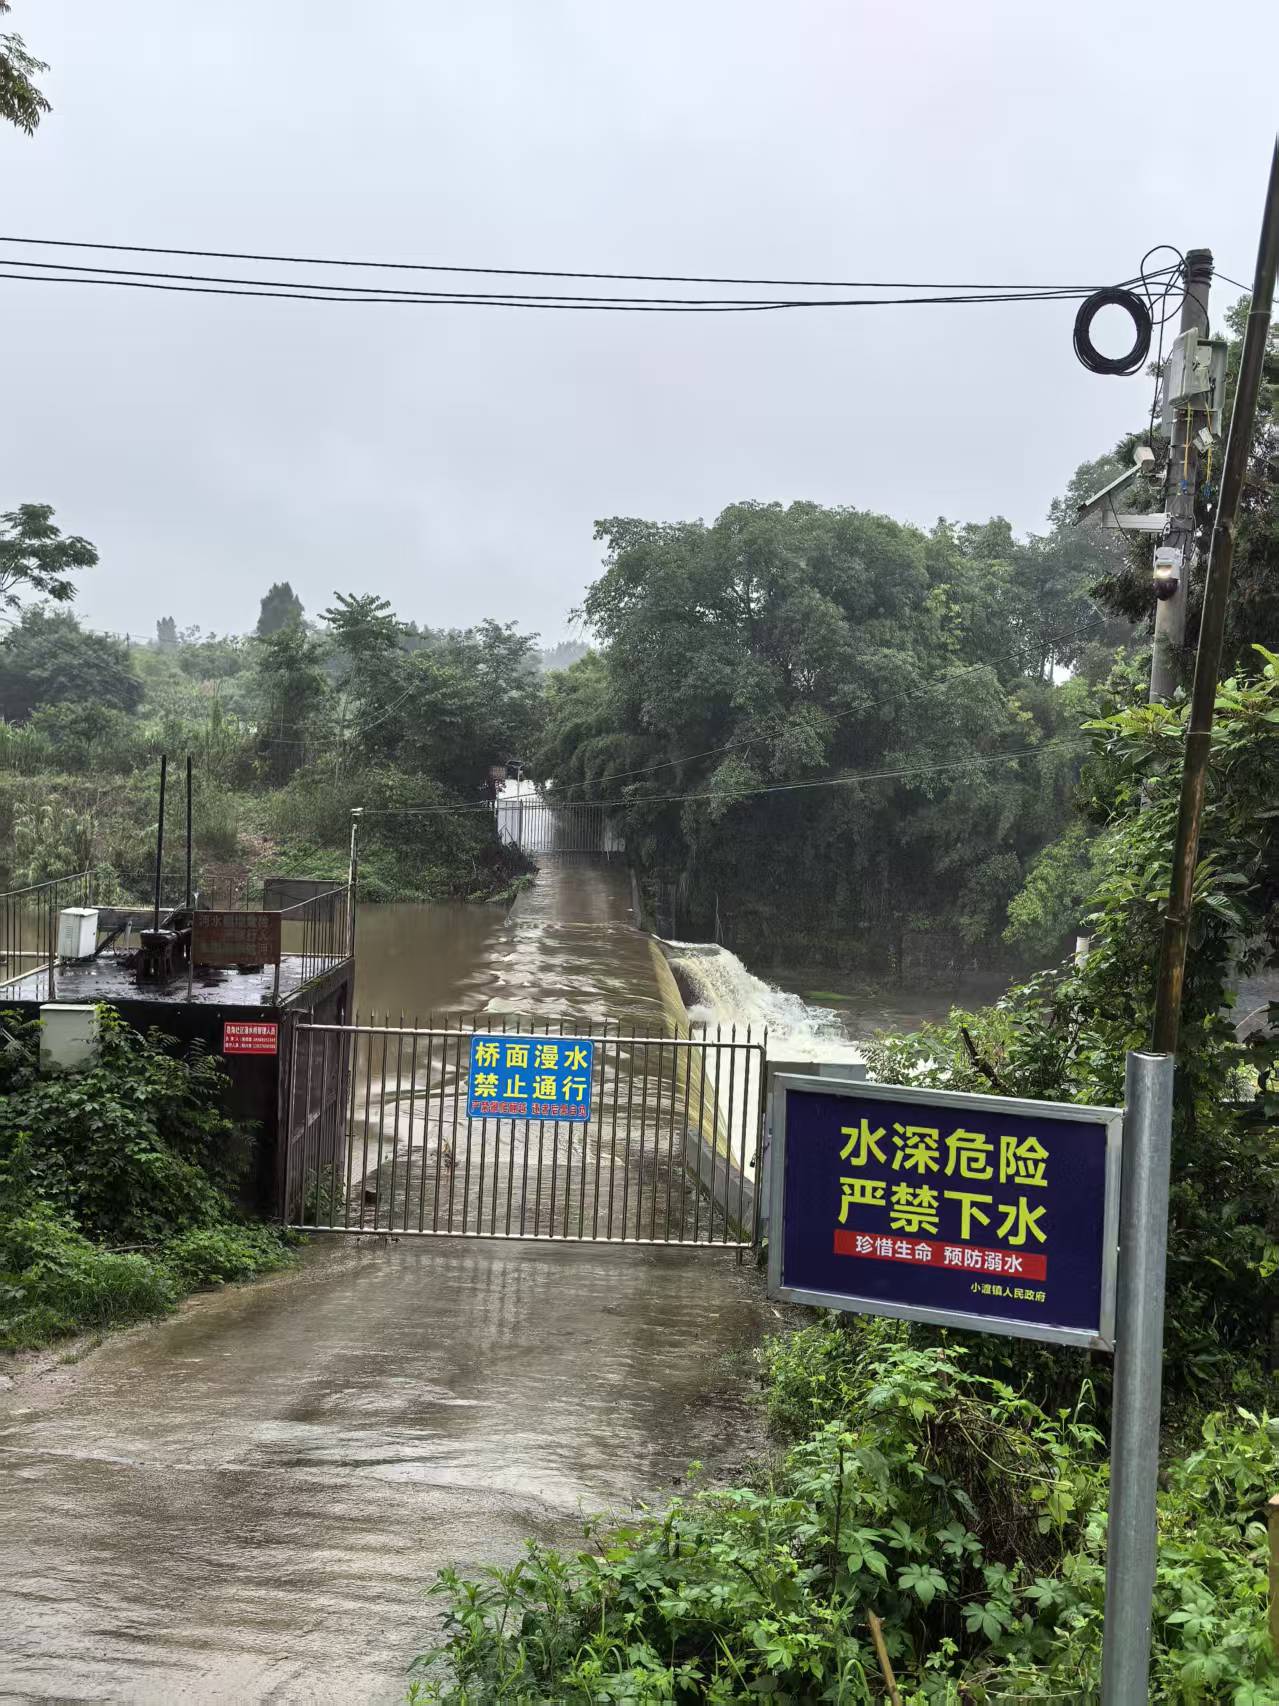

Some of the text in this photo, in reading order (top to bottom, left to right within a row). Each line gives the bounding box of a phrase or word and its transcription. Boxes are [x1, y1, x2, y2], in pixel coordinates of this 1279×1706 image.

[475, 1041, 589, 1071] 桥面漫水
[474, 1072, 587, 1101] 禁止通行
[839, 1118, 1050, 1187] 水深危险
[837, 1176, 1048, 1246] 严禁下水
[855, 1235, 1023, 1273] 珍惜生命 预防溺水
